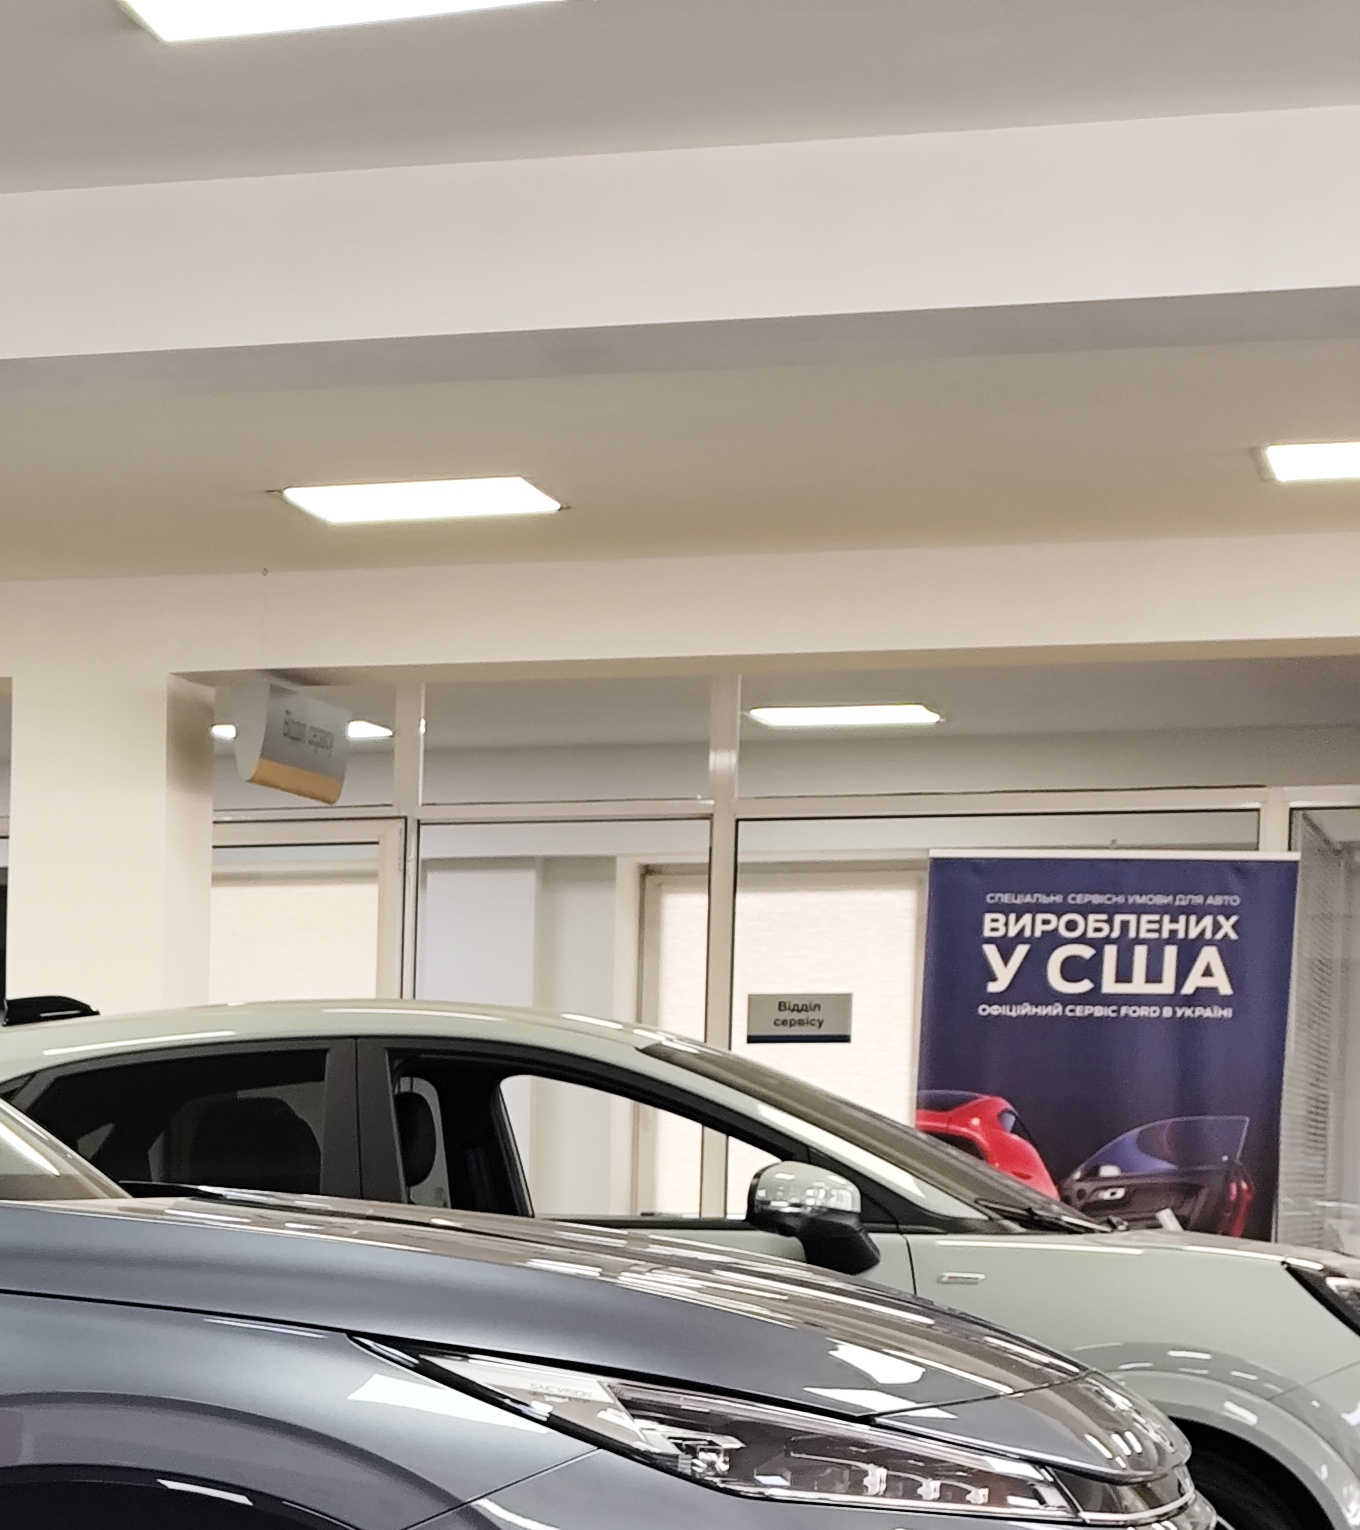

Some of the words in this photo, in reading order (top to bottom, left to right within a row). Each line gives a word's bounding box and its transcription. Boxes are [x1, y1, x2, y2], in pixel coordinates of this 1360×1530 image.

[985, 893, 1064, 904] СПЕЦІАЛЬНІ
[1067, 893, 1126, 905] СЕРВІСНІ
[1127, 893, 1173, 905] УМОВИ
[1175, 893, 1203, 906] ДЛЯ
[1205, 894, 1242, 906] АВТО
[982, 912, 1240, 941] ВИРОБЛЕНИХ
[982, 943, 1032, 995] У
[1046, 942, 1235, 997] США
[777, 1000, 822, 1013] Відділ
[977, 1002, 1063, 1018] ОФІЦІЙНИЙ
[1065, 1004, 1118, 1018] СЕРВІС
[1119, 1005, 1161, 1018] FORD
[1162, 1005, 1173, 1018] В
[1175, 1004, 1233, 1019] УКРАЇНІ
[773, 1017, 825, 1029] сервісу
[530, 1382, 555, 1393] SAIC
[557, 1386, 592, 1398] VISION
